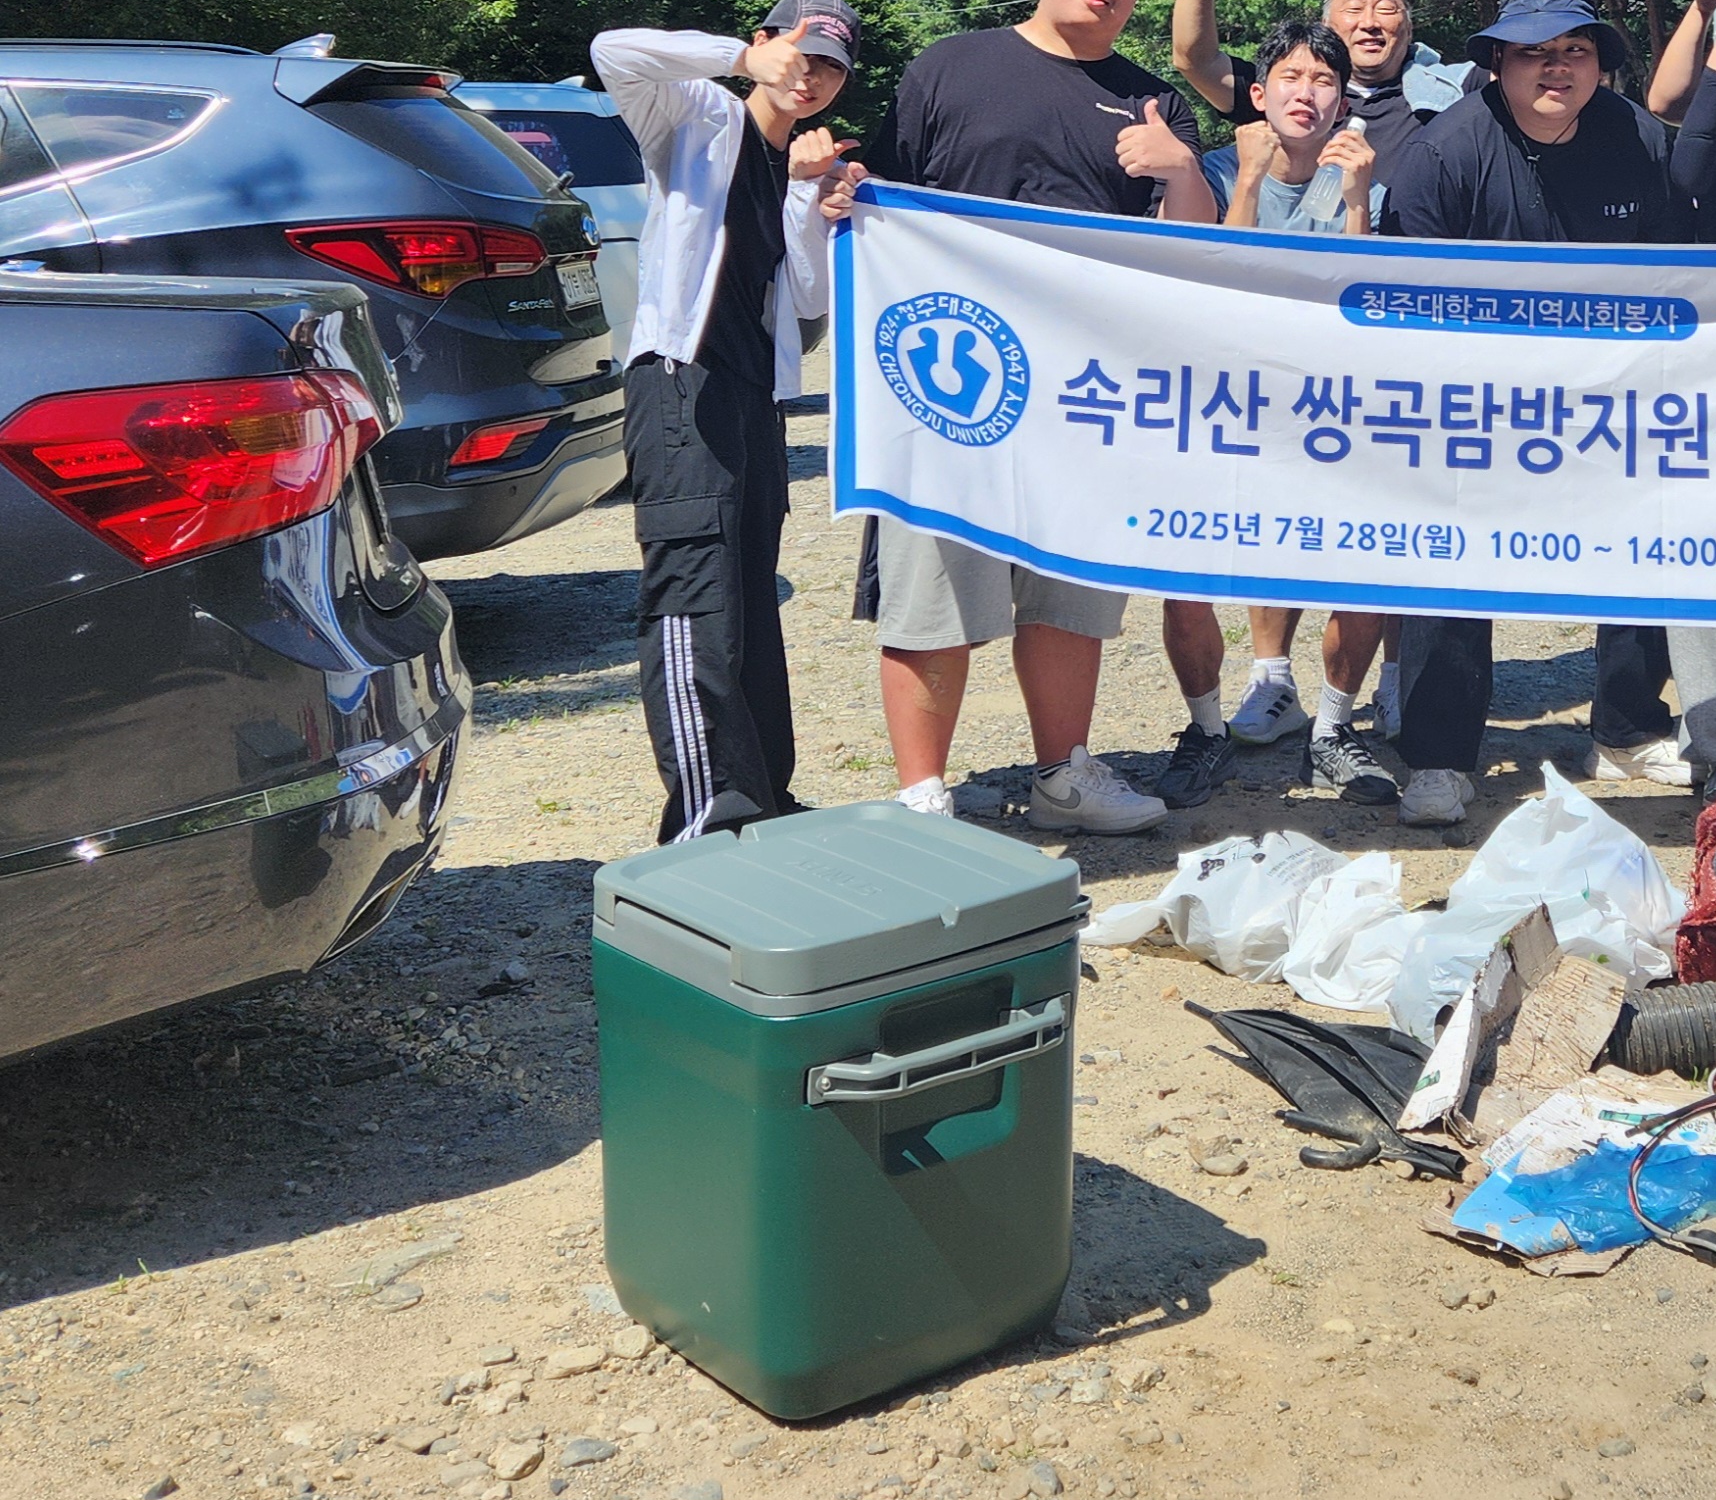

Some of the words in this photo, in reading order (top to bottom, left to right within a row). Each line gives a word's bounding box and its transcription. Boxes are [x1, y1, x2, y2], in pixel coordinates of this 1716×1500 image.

[878, 314, 899, 348] 1924
[896, 295, 1001, 335] 청주대학교
[1363, 291, 1500, 325] 청주대학교
[1509, 298, 1679, 335] 지역사회봉사
[1001, 342, 1026, 385] 1947
[878, 352, 942, 431] CHEONGJU
[945, 388, 1024, 444] UNIVERSITY
[1058, 358, 1269, 456] 속리산
[1145, 507, 1262, 547] 2025년
[1273, 516, 1325, 552] 7월
[1336, 520, 1467, 561] 28일(월)
[1490, 530, 1582, 563] 10:00
